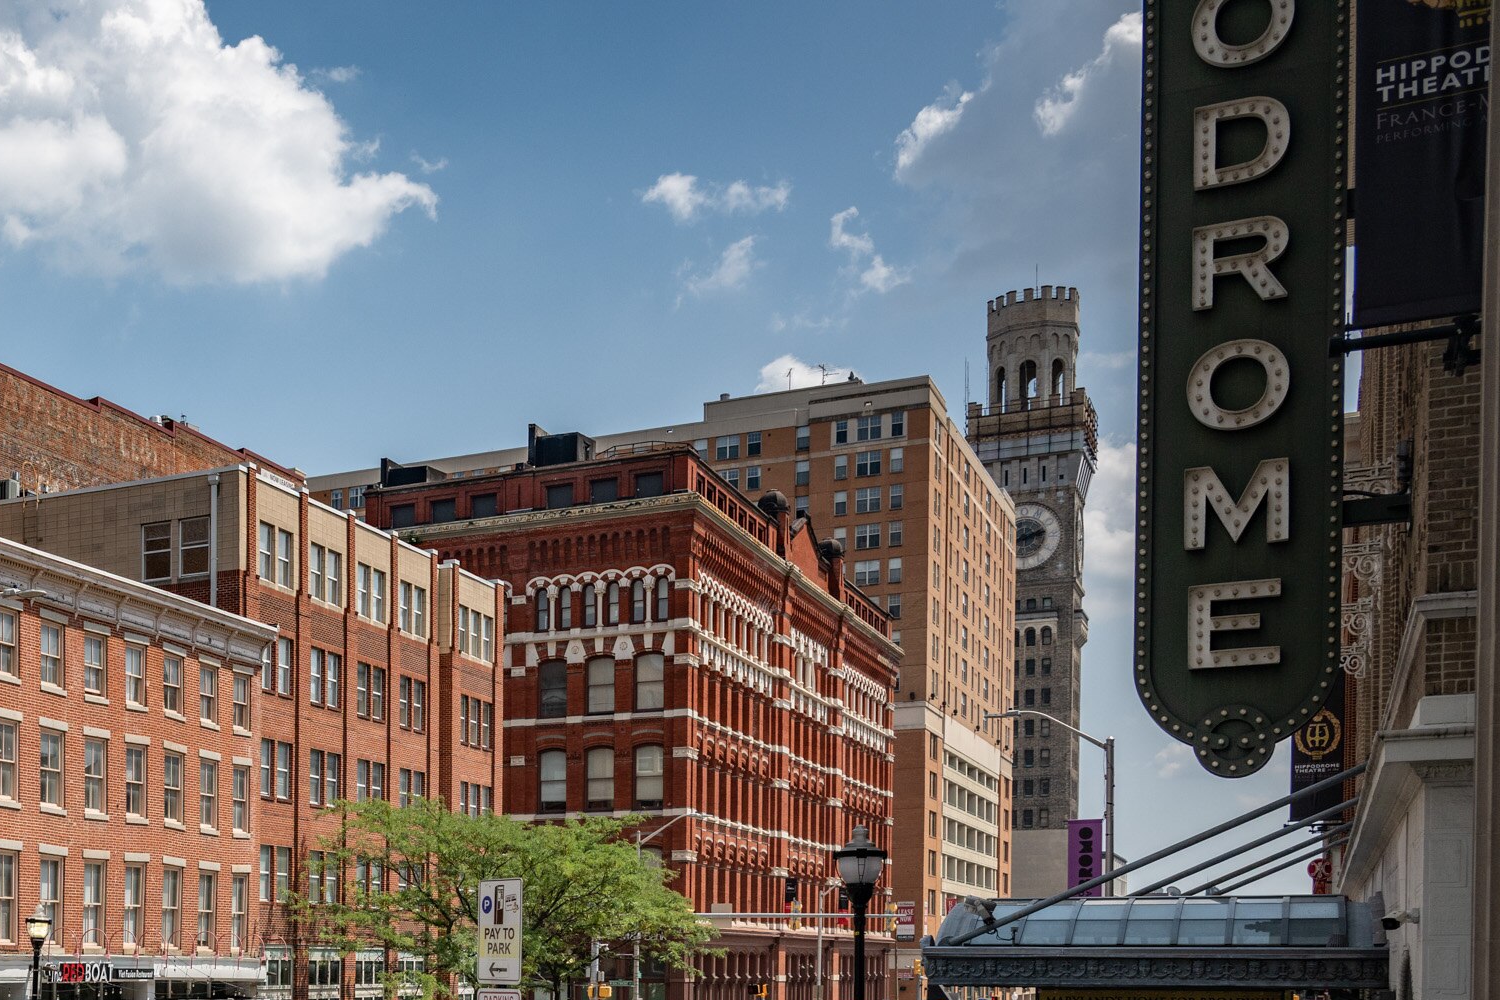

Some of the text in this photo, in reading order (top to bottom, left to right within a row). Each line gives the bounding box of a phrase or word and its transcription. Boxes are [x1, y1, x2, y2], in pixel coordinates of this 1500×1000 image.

[484, 928, 515, 940] PAY TO
[487, 942, 511, 955] PARK
[63, 963, 85, 982] RED
[85, 963, 114, 982] BOAT
